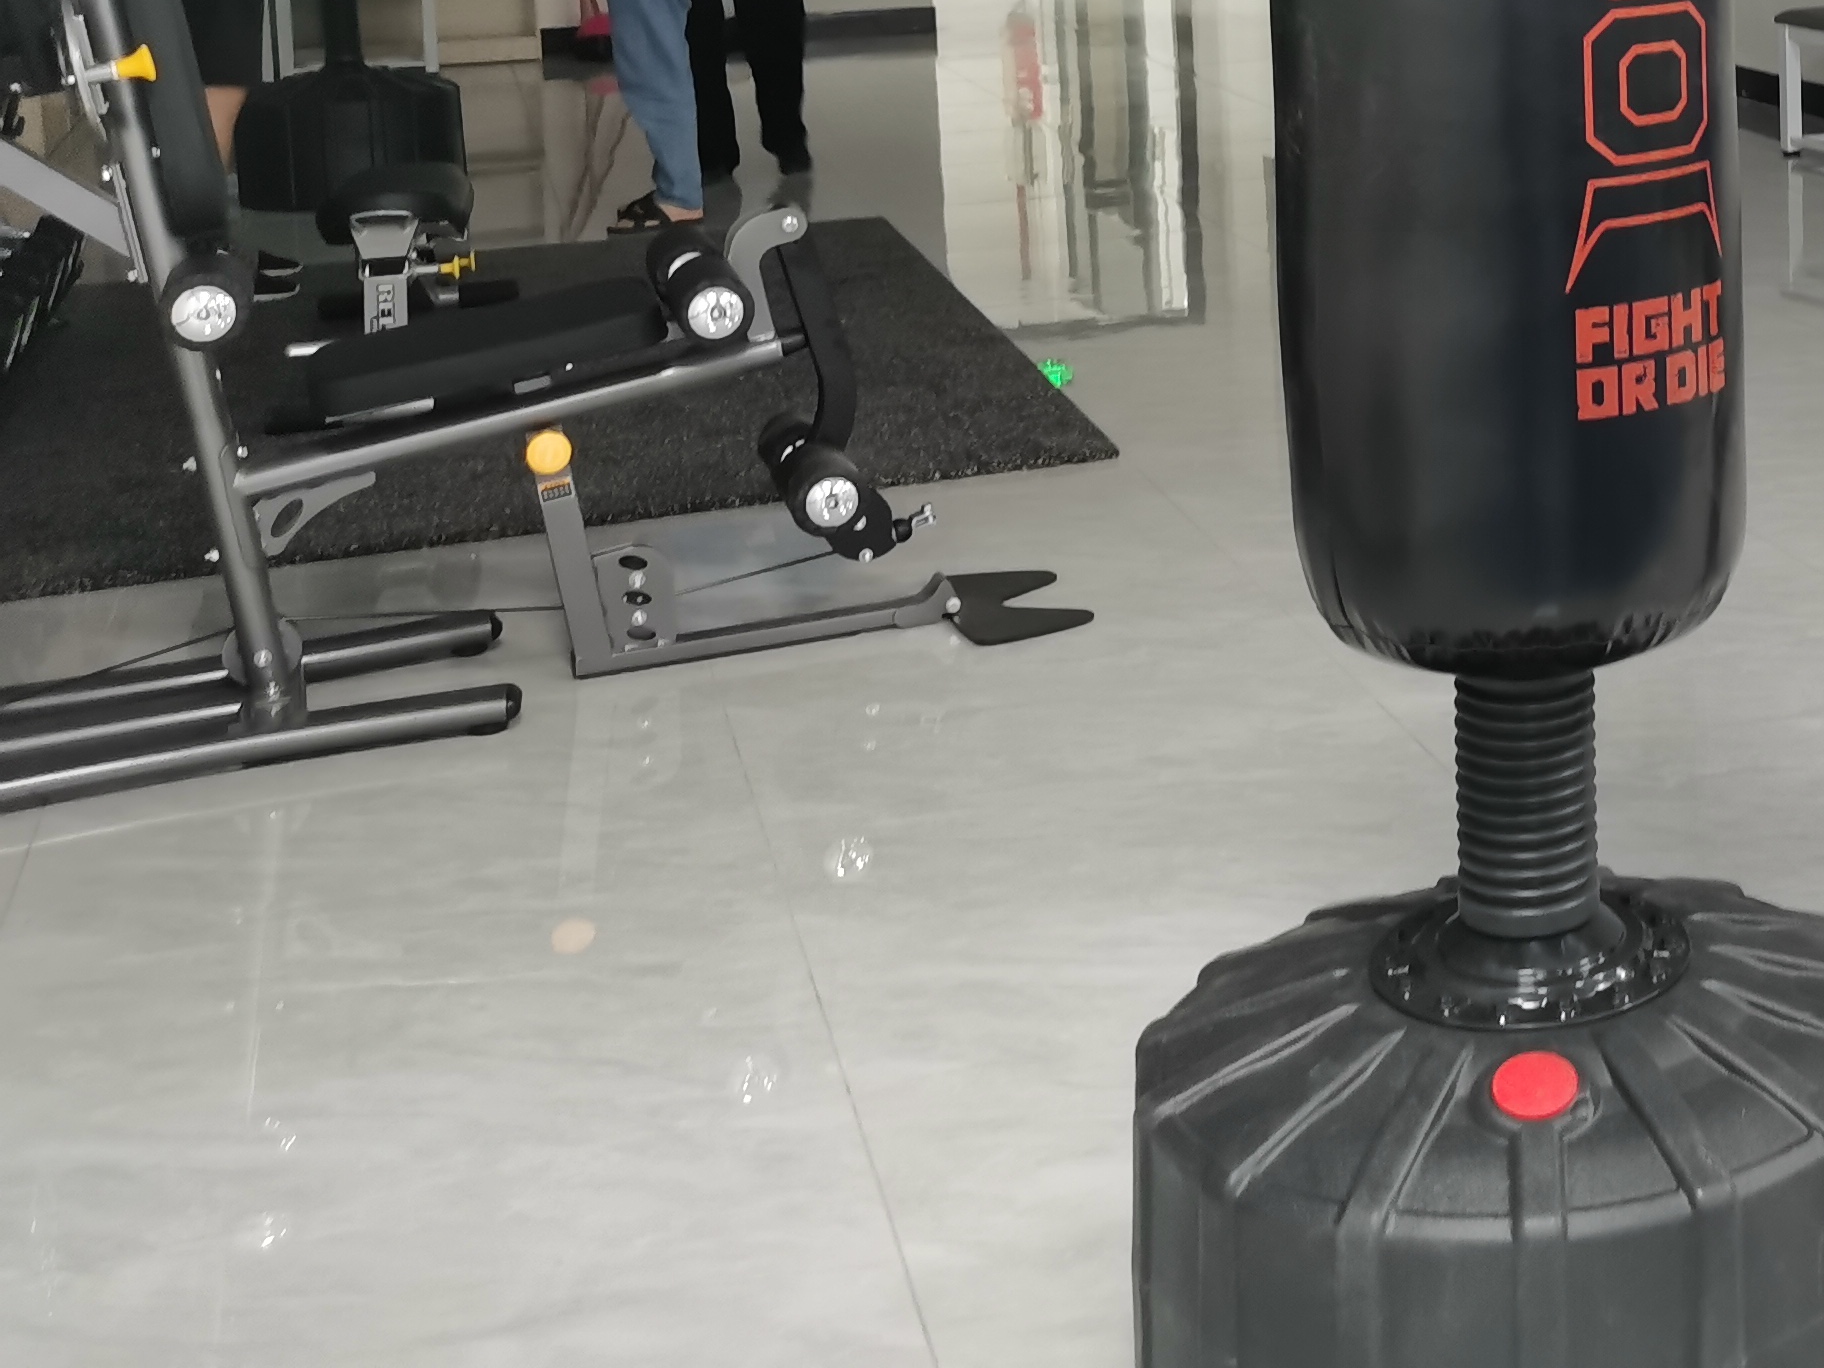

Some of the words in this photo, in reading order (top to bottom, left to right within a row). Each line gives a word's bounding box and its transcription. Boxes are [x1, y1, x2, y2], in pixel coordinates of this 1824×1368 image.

[1574, 278, 1723, 364] FIGHT
[1576, 359, 1660, 421] OR
[1665, 336, 1726, 406] DIE
